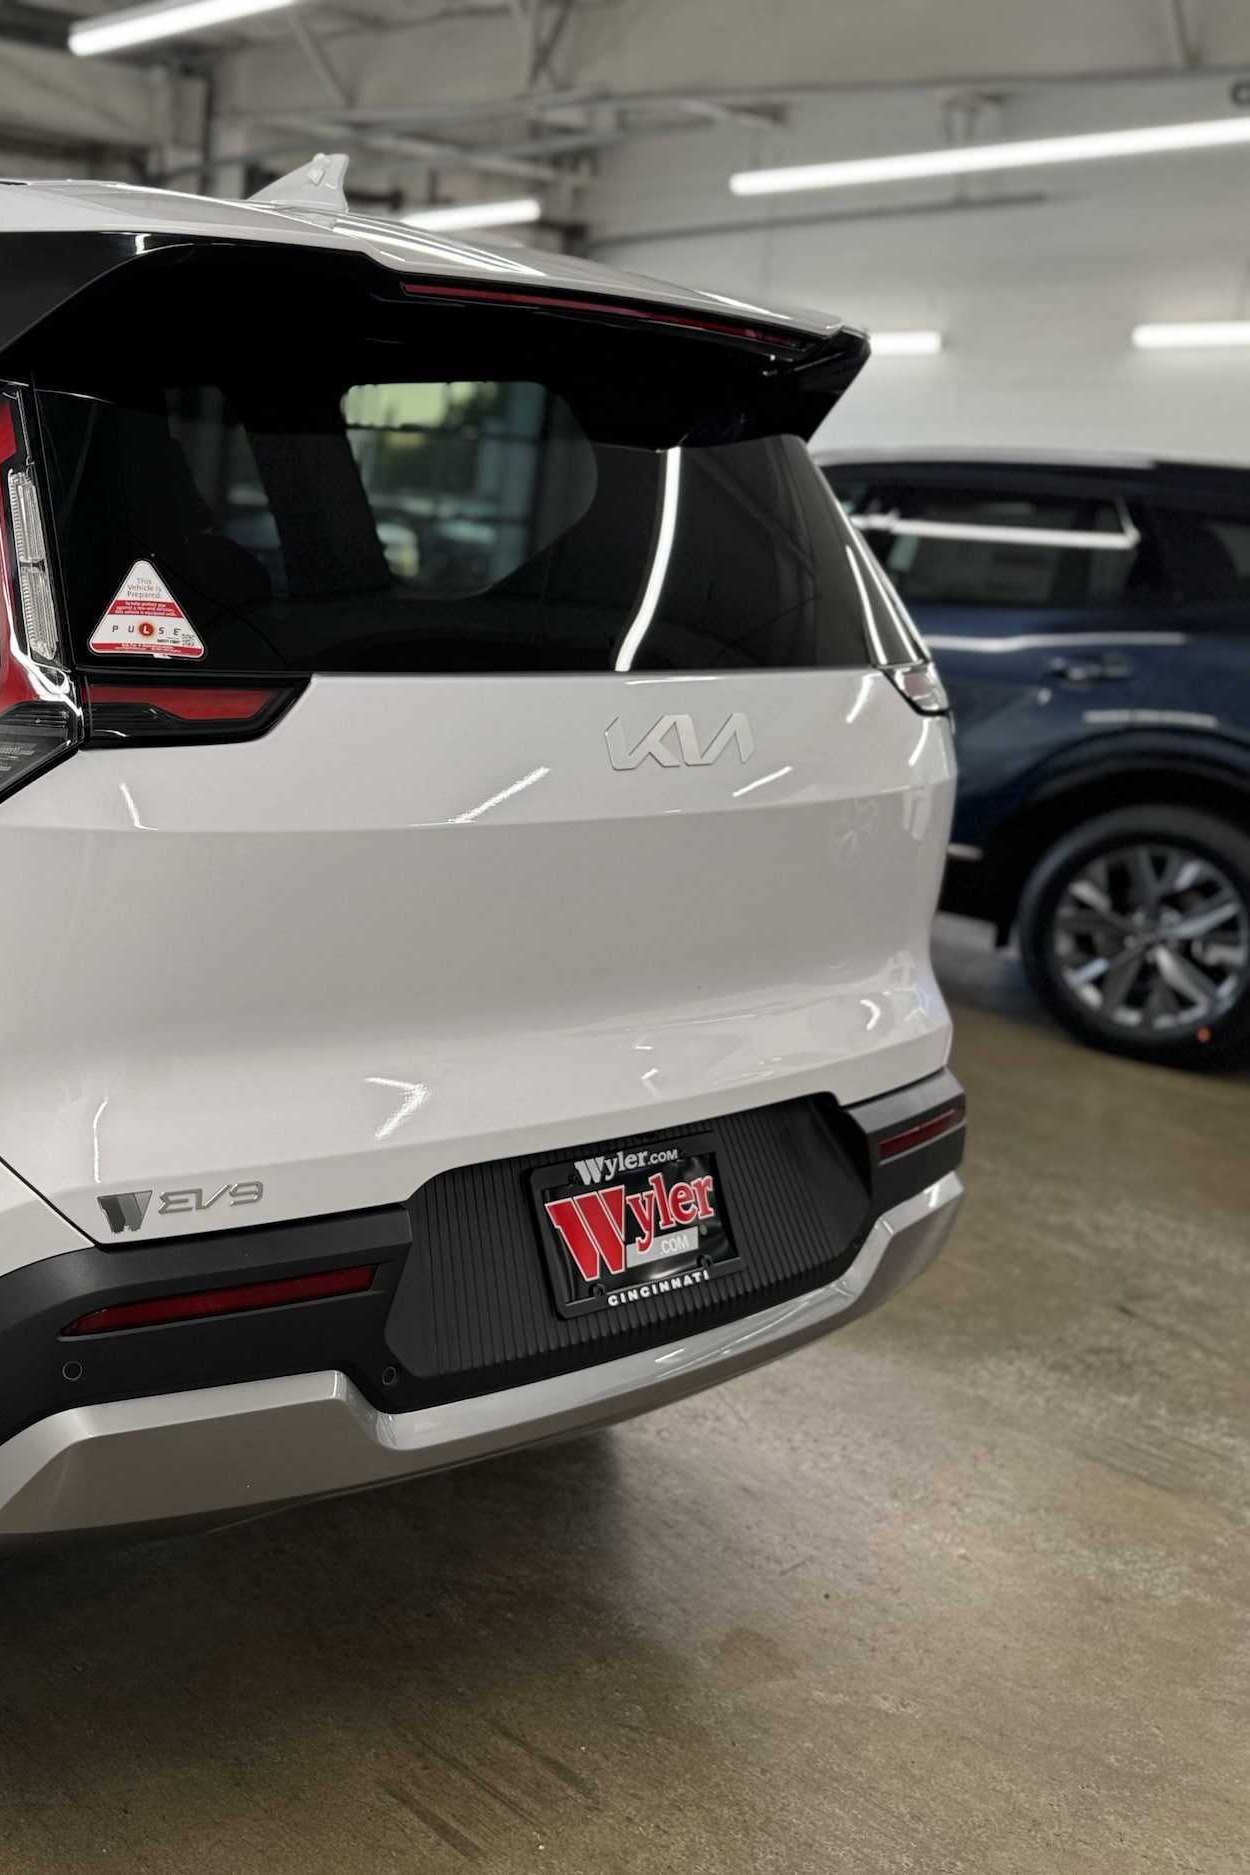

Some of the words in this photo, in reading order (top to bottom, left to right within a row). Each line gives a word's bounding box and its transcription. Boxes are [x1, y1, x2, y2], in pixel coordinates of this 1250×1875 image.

[127, 584, 154, 592] Vehicle
[136, 577, 152, 585] This
[112, 624, 182, 636] PULSE
[605, 712, 755, 771] KIA
[158, 1180, 263, 1214] EV9
[544, 1172, 715, 1282] Wyler
[607, 1269, 710, 1307] CINCINNATI
